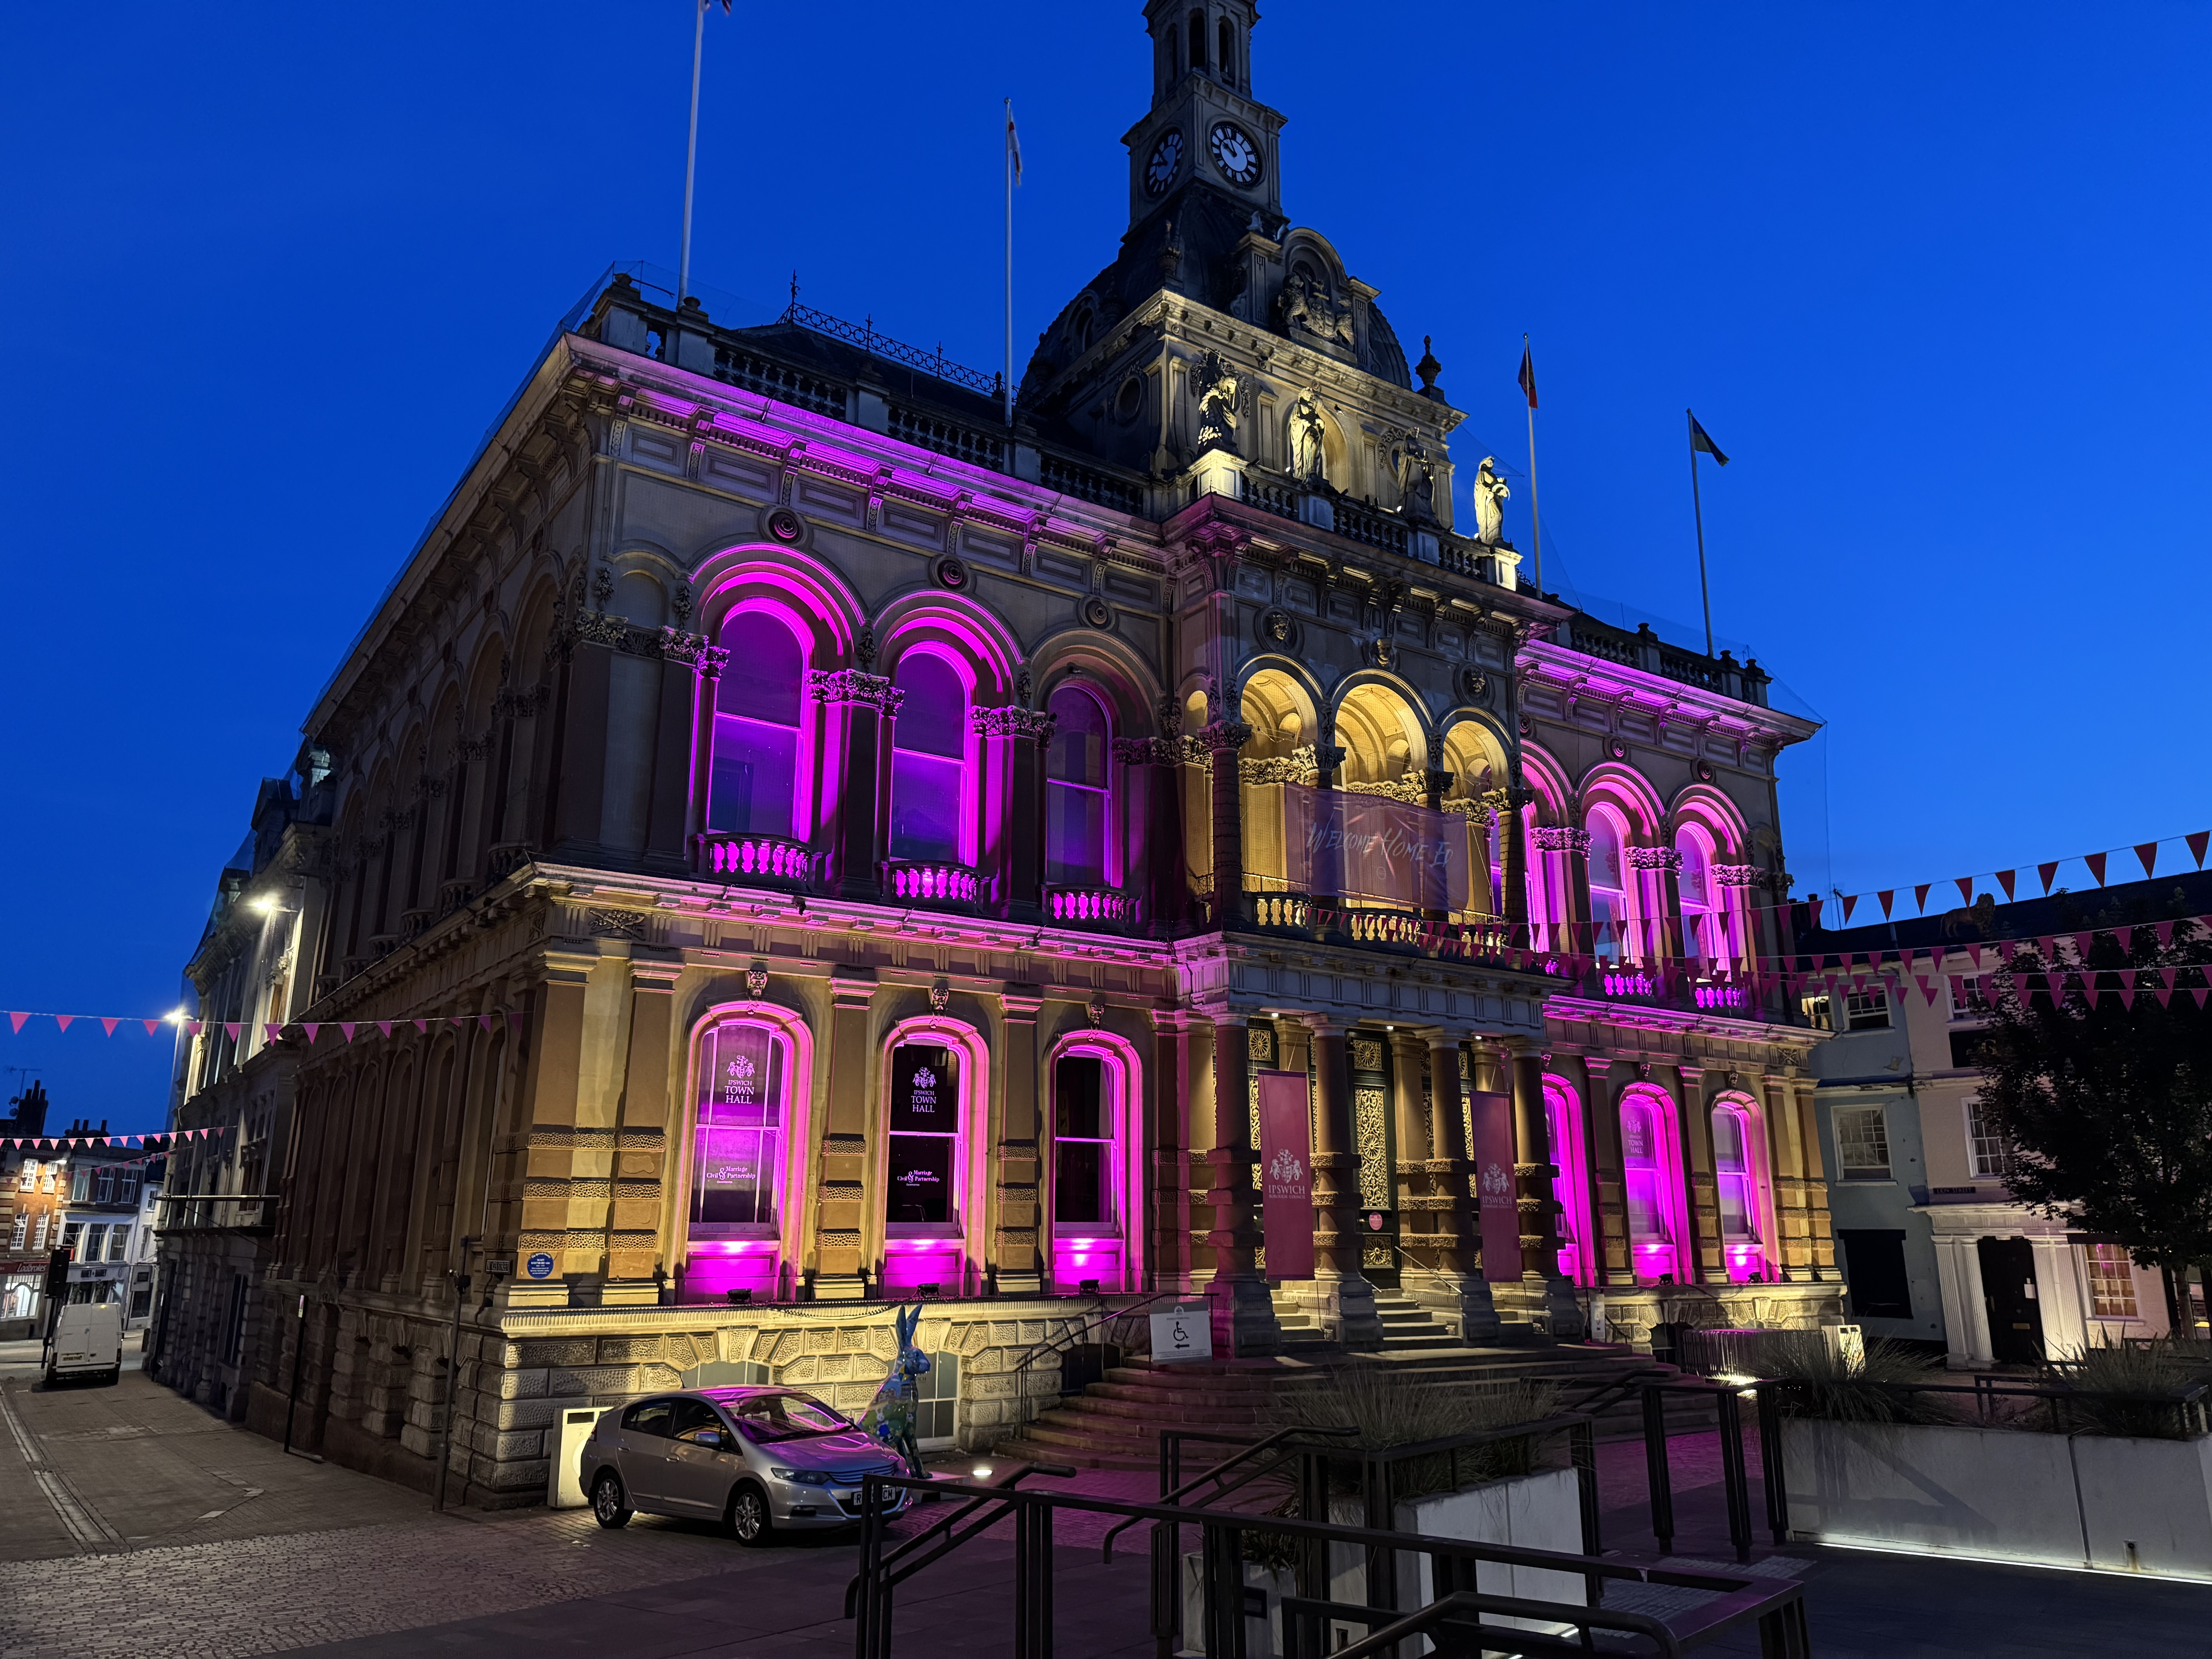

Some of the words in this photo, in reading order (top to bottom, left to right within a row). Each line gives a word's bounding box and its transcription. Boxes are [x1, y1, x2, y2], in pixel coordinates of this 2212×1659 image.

[725, 1085, 754, 1095] TOWN
[725, 1095, 752, 1104] HALL
[910, 1096, 937, 1104] TOWN
[912, 1104, 935, 1113] HALL
[718, 1168, 726, 1180] &
[907, 1171, 914, 1183] &
[1269, 1185, 1305, 1194] IPSWICH
[1482, 1195, 1512, 1204] IPSWICH
[17, 1263, 47, 1272] Ladbrokes
